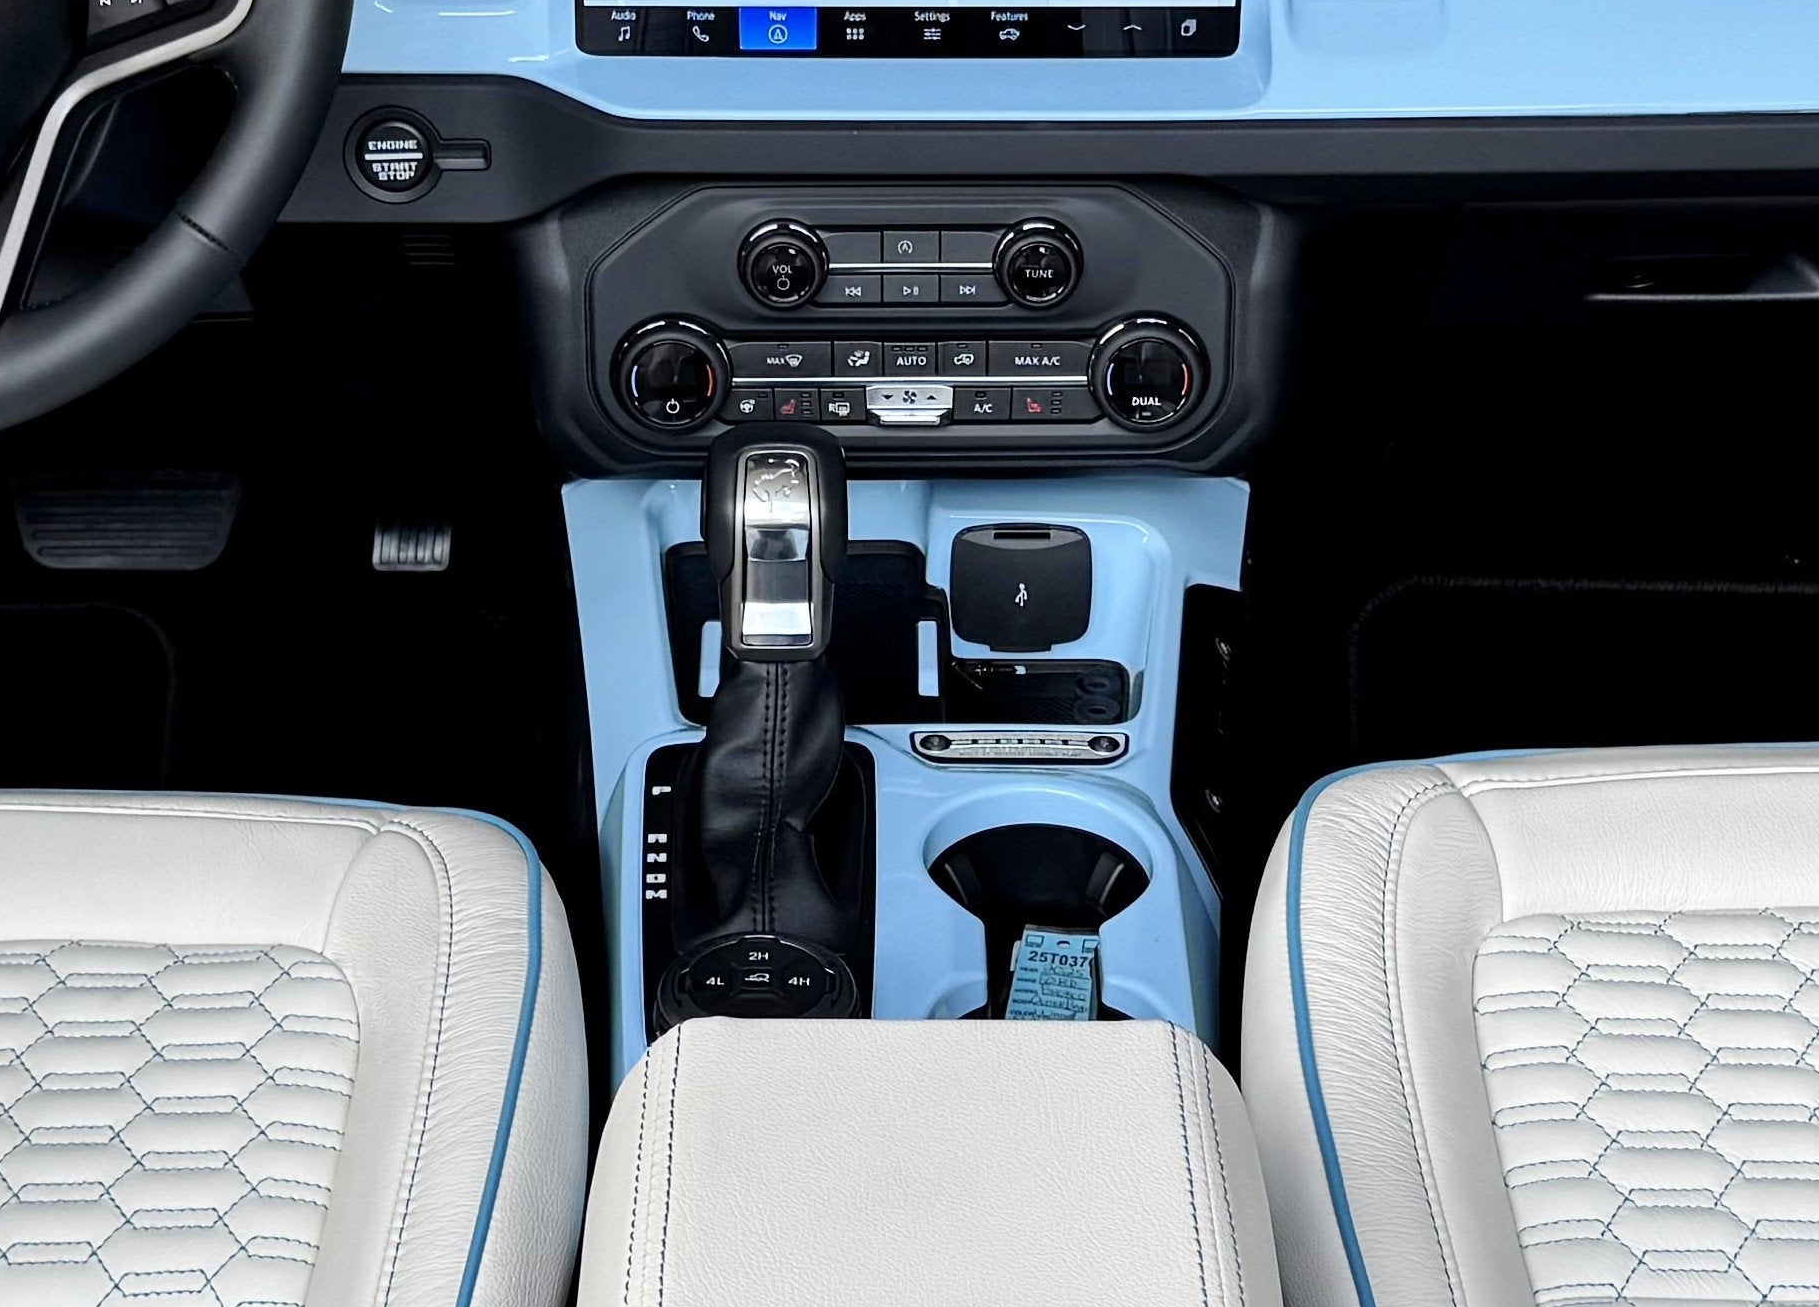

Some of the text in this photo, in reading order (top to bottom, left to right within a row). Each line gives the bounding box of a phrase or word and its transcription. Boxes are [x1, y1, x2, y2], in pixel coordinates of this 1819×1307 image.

[611, 10, 636, 21] Audio
[687, 10, 715, 21] Phone
[769, 10, 787, 21] Nav
[843, 10, 866, 23] Apps
[914, 10, 950, 23] Settings
[990, 10, 1029, 22] Features
[378, 171, 415, 181] STOP
[772, 264, 793, 275] VOL
[1025, 269, 1054, 279] TUNE
[896, 356, 927, 366] AUTO
[1015, 356, 1061, 366] MAX A/C
[1131, 396, 1161, 406] DUAL
[973, 403, 993, 413] A/C
[646, 852, 667, 863] N
[748, 951, 769, 961] 2H
[706, 976, 725, 986] 4L
[788, 976, 810, 986] 4H
